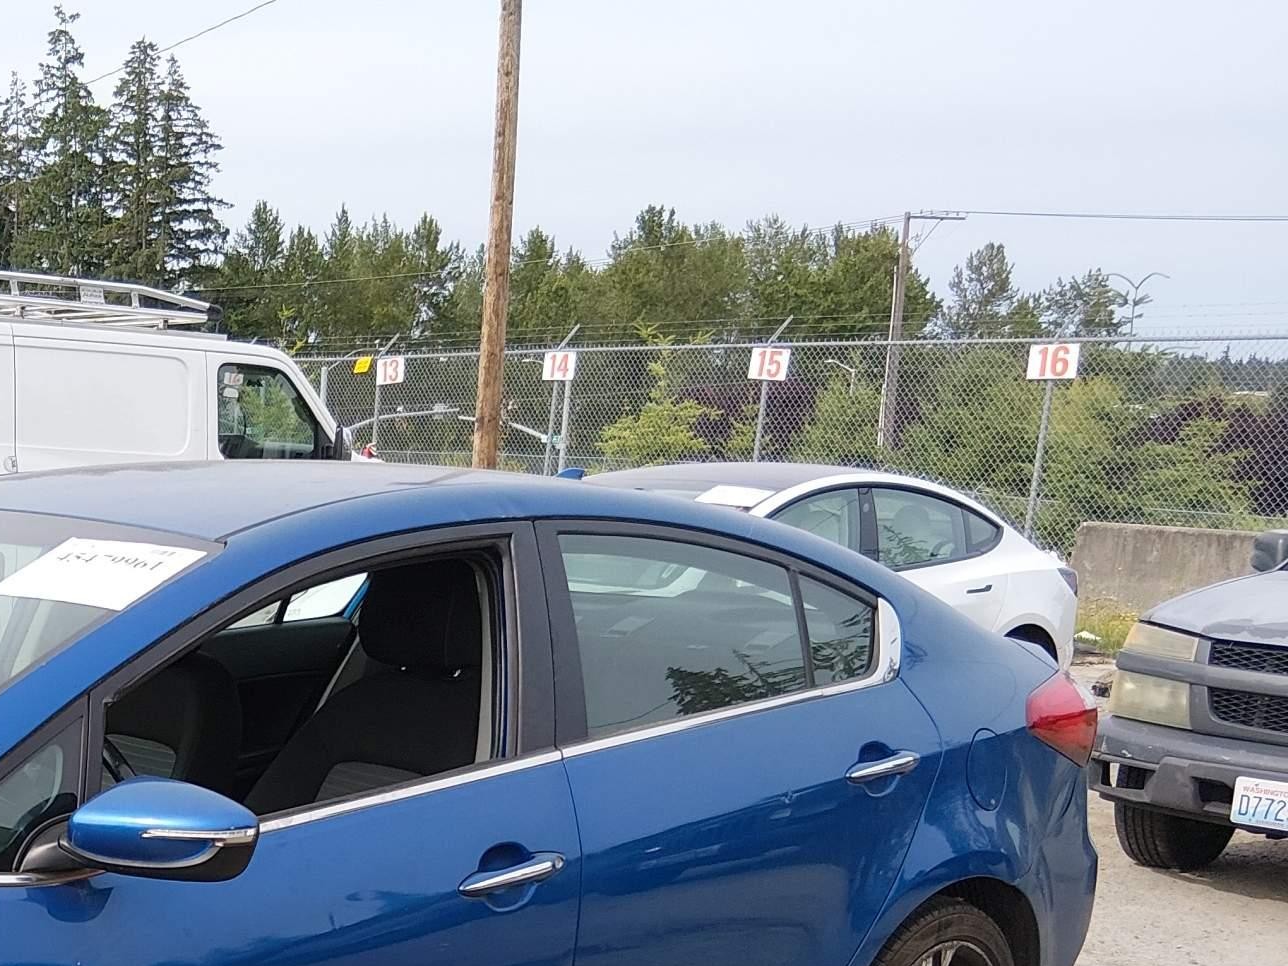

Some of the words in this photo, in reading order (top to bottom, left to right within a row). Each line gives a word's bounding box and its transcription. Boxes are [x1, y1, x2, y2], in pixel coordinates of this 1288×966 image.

[382, 359, 399, 382] 13
[551, 354, 569, 378] 14
[758, 350, 783, 379] 15
[1039, 346, 1070, 377] 16
[1238, 794, 1288, 822] D772
